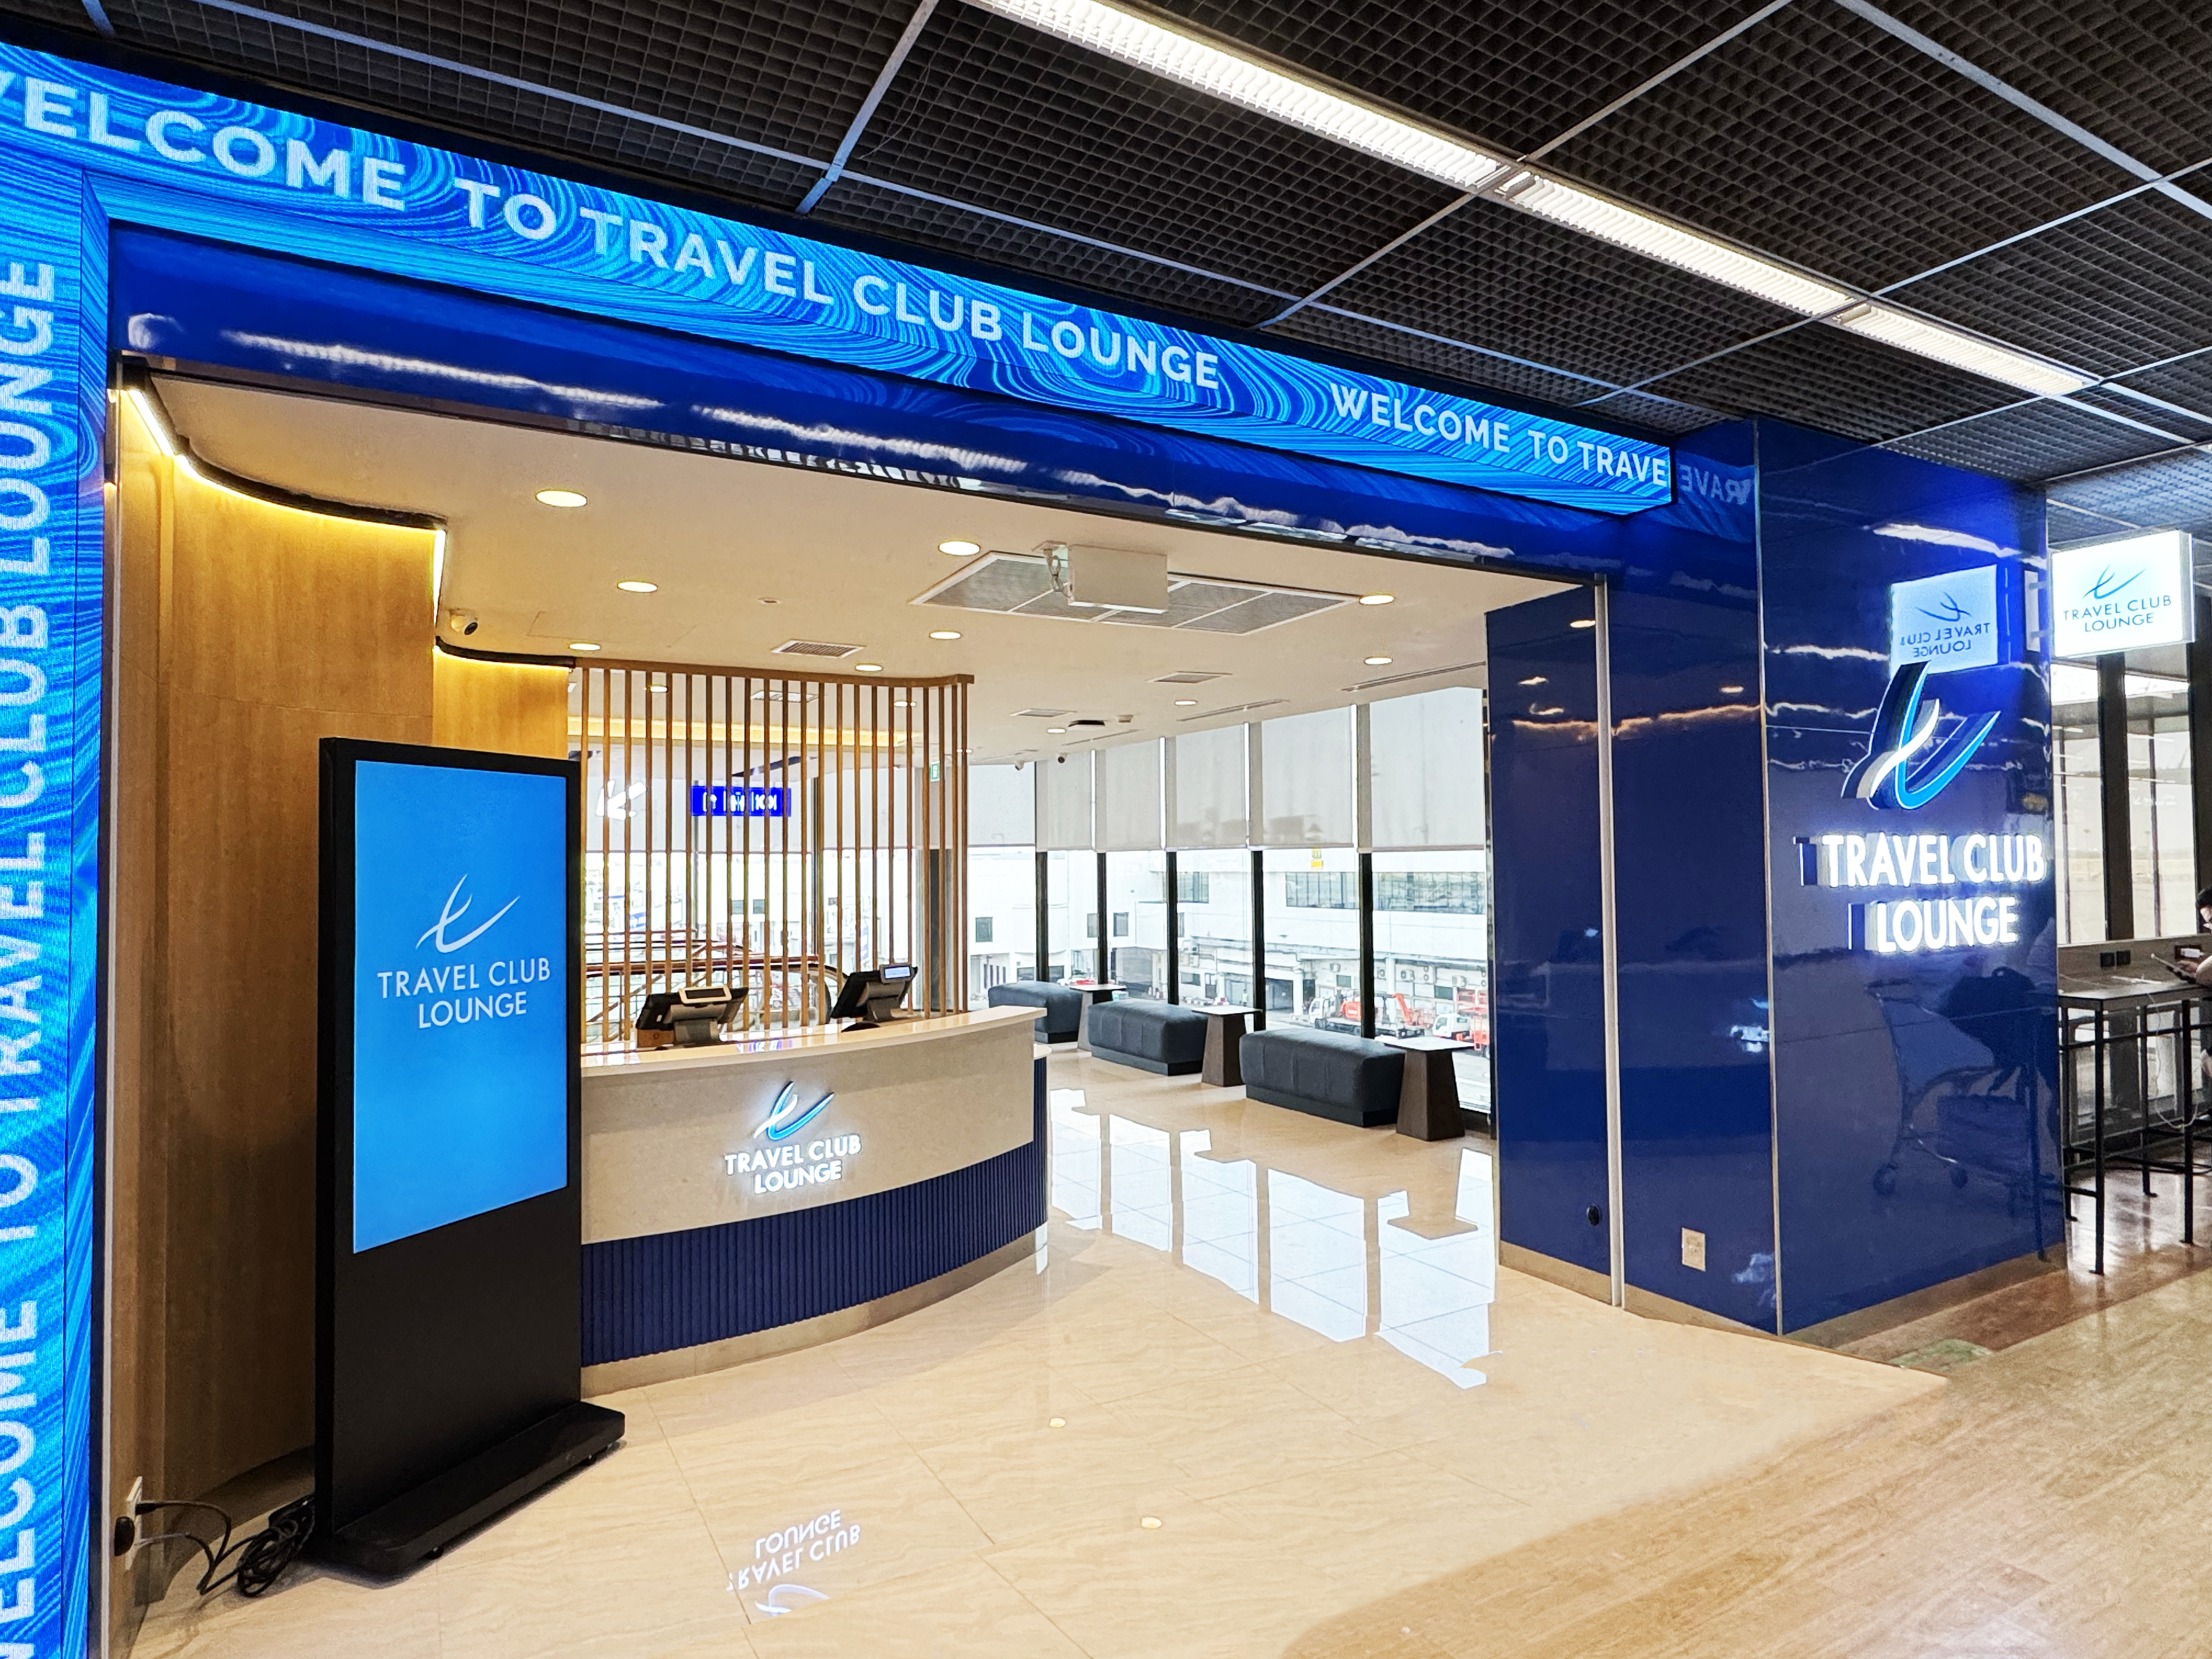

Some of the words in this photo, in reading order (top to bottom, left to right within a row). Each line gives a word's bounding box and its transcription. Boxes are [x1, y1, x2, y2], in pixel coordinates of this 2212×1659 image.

[0, 70, 405, 211] ELCOME
[454, 178, 556, 240] TO
[580, 207, 834, 305] TRAVEL
[853, 275, 1003, 341] CLUB
[1023, 312, 1219, 390] LOUNGE
[0, 262, 54, 576] LOUNGE
[1330, 383, 1510, 453] WELCOME
[1527, 430, 1568, 464] TO
[1577, 441, 1667, 487] TRAVE
[2063, 603, 2121, 620] TRAVEL
[2127, 595, 2171, 611] CLUB
[2085, 613, 2154, 632] LOUNGE
[1822, 832, 1955, 888] TRAVEL
[1962, 833, 2047, 883] CLUB
[1876, 896, 2019, 953] LOUNGE
[378, 964, 479, 998] TRAVEL
[488, 957, 550, 986] CLUB
[419, 991, 527, 1029] LOUNGE
[725, 1144, 804, 1175] TRAVEL
[809, 1134, 861, 1161] CLUB
[754, 1160, 842, 1194] LOUNGE
